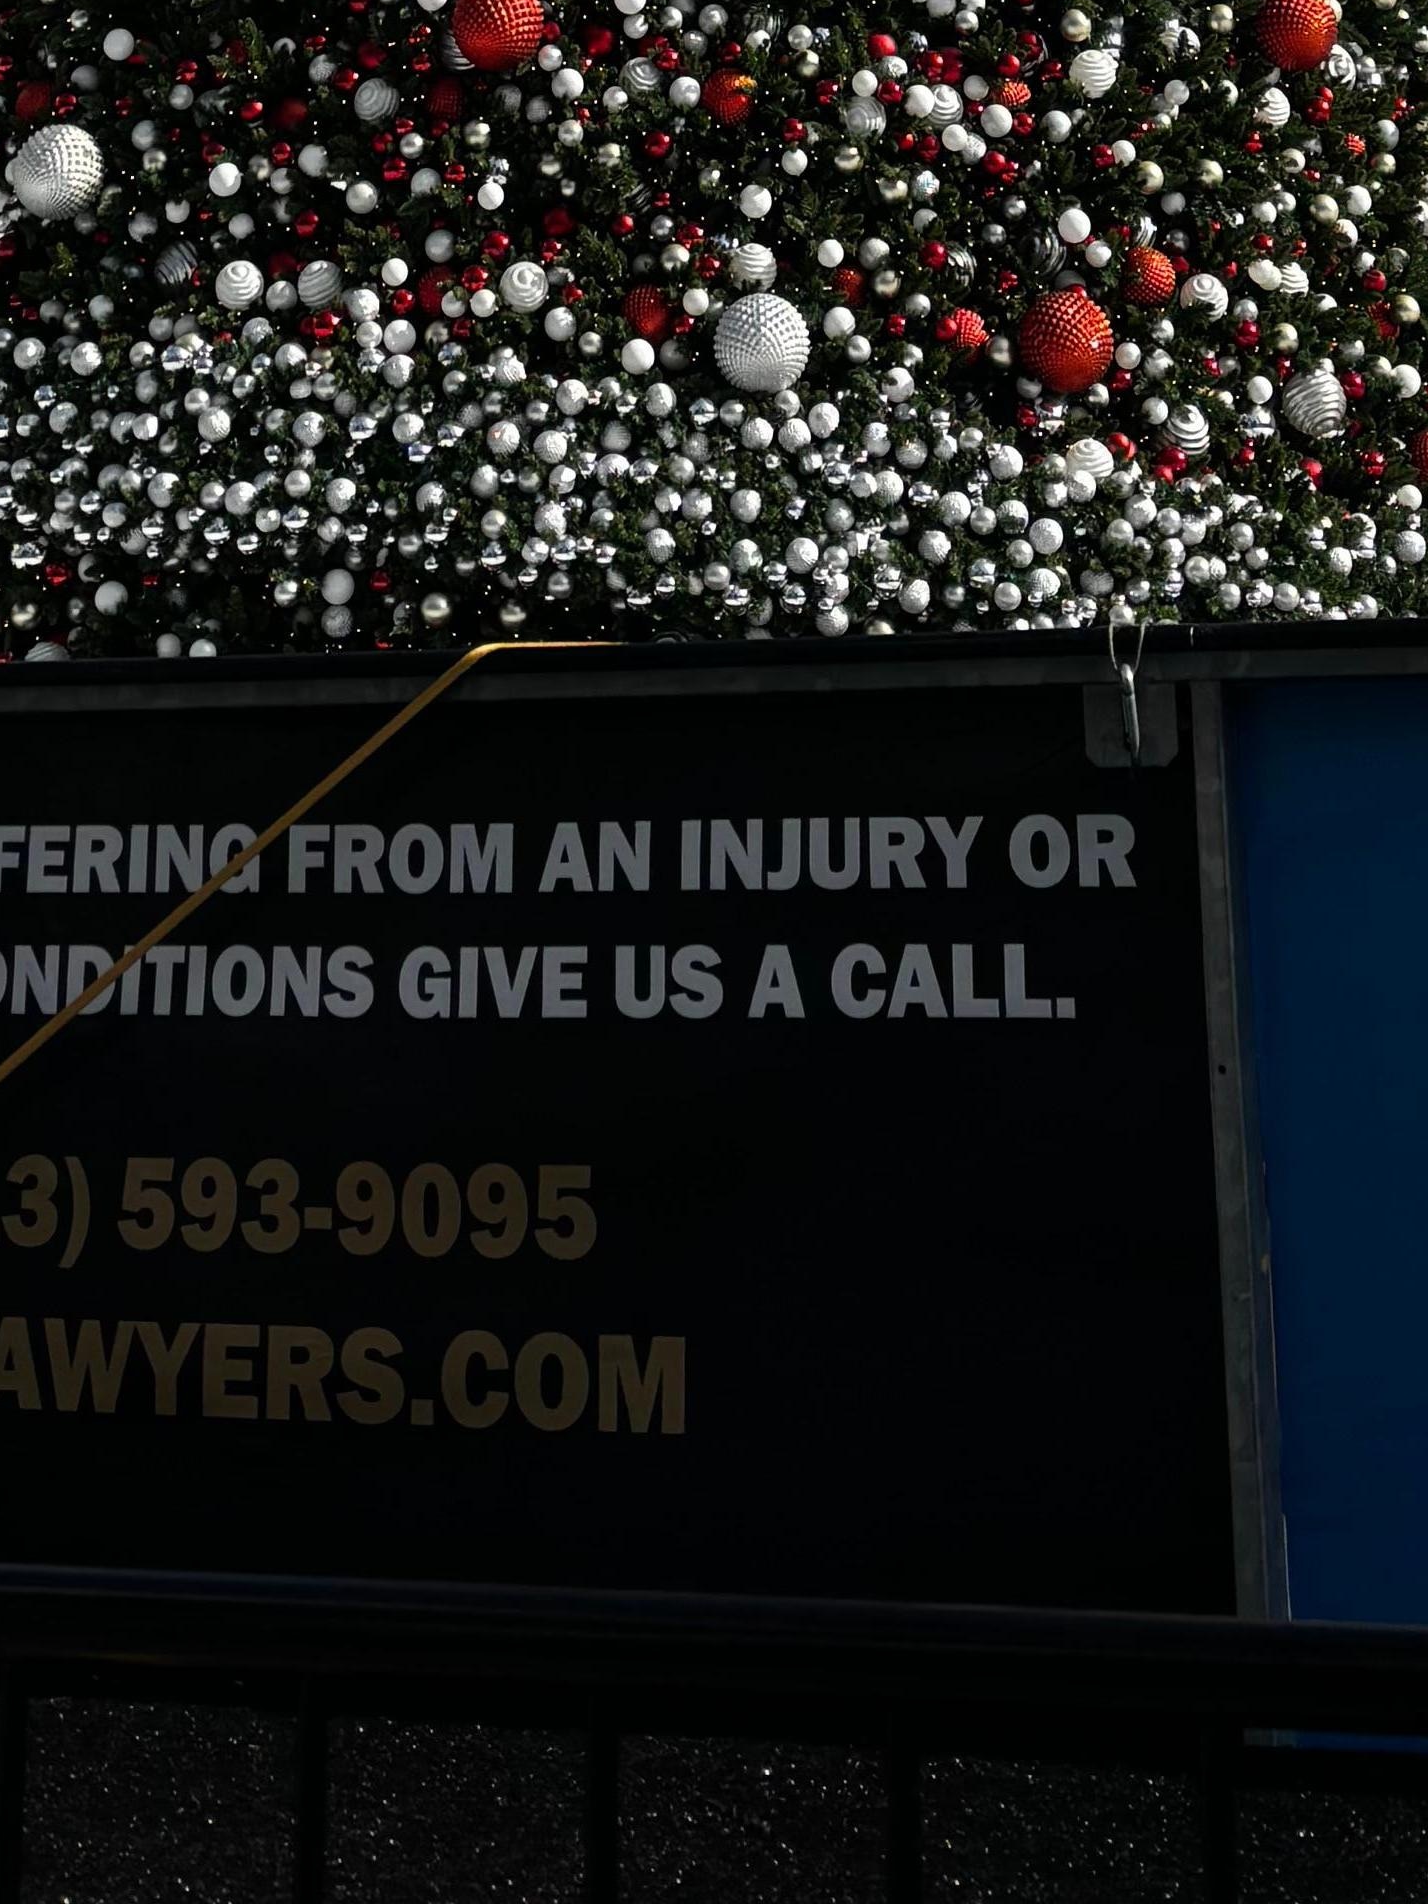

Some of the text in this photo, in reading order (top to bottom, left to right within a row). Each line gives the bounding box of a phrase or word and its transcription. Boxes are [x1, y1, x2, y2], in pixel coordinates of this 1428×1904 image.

[286, 821, 514, 894] FROM
[537, 819, 651, 894] AN
[680, 815, 983, 892] INJURY
[1009, 814, 1137, 889] OR
[397, 944, 588, 1020] GIVE
[616, 944, 724, 1020] US
[748, 944, 806, 1020] A
[830, 942, 1077, 1020] CALL.
[117, 1155, 598, 1263] 593-9095
